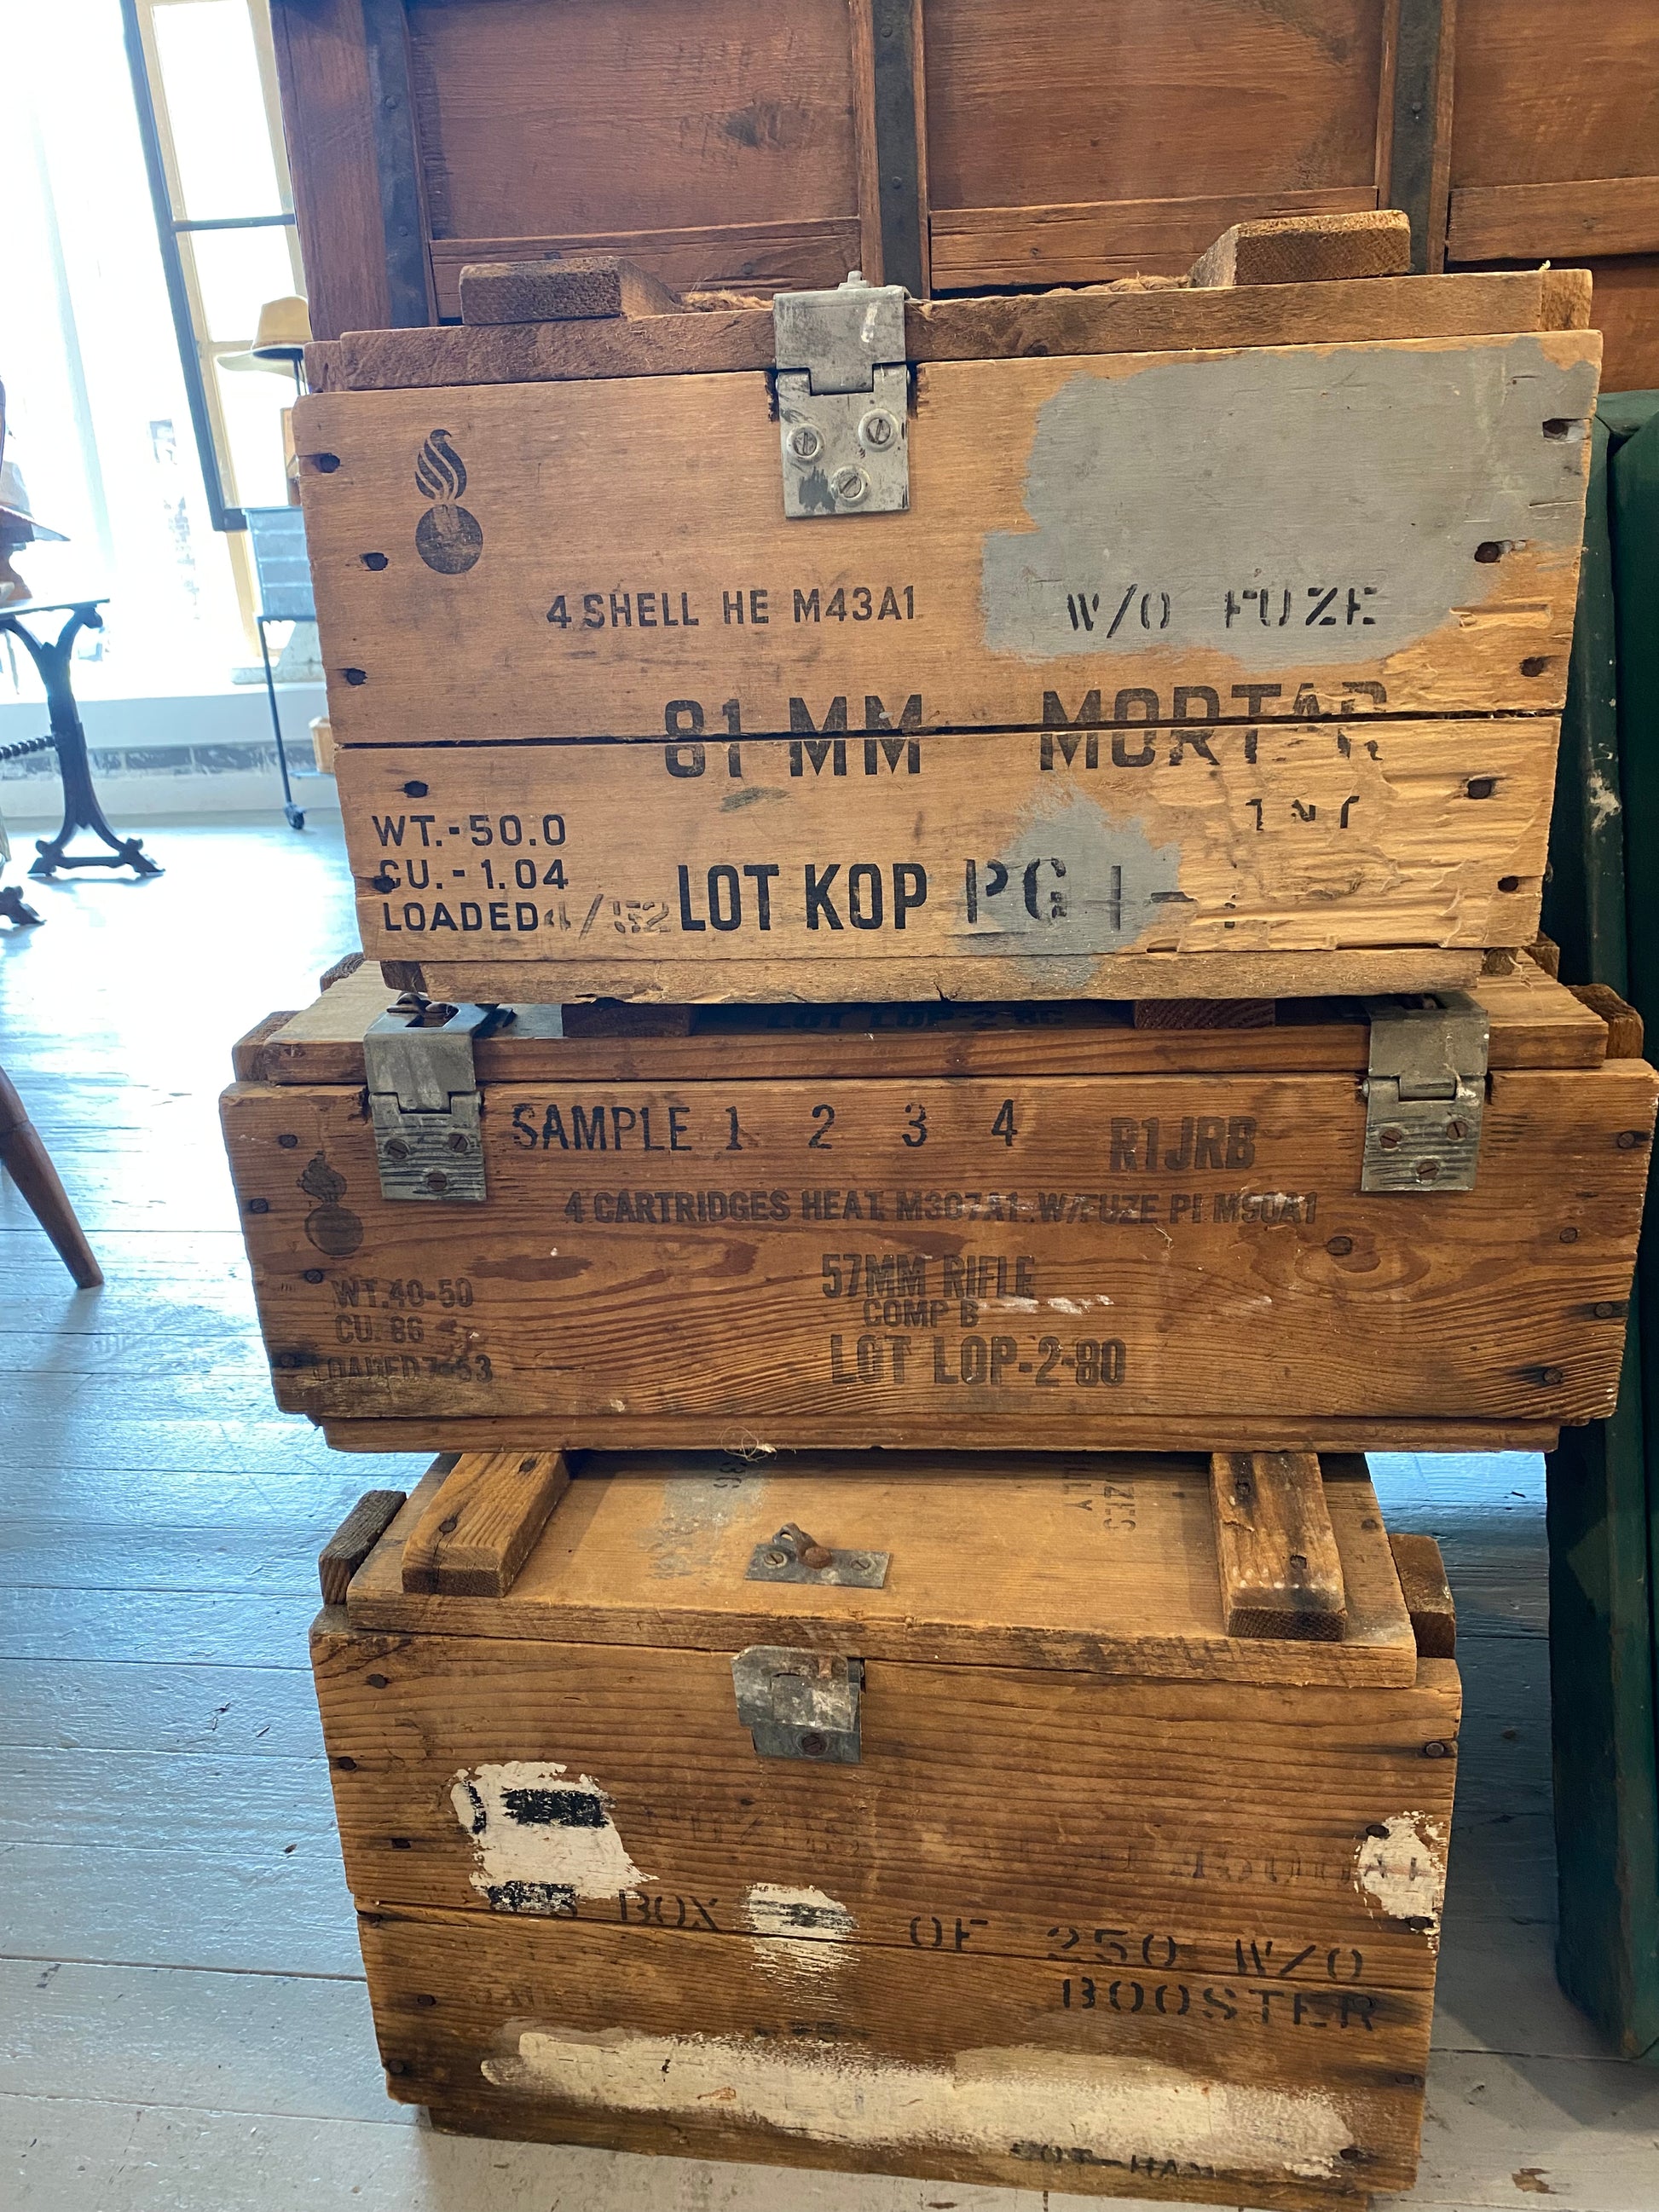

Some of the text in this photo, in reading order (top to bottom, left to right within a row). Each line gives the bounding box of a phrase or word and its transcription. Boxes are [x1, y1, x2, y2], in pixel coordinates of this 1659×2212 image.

[547, 586, 916, 628] 4 SHELL HE M43A1
[1066, 583, 1378, 638] W/O FUZE
[664, 698, 742, 778] 81
[789, 694, 922, 777] MM
[382, 901, 540, 933] LOADED
[678, 863, 779, 932] LOT
[805, 863, 928, 931] KOP
[963, 856, 1066, 925] PG
[512, 1098, 1018, 1152] SAMPLE 1 2 3 4
[564, 1191, 586, 1223] 4
[593, 1188, 791, 1224] CARTRIDGES
[822, 1253, 1036, 1299] 57MM RIFLE
[862, 1297, 980, 1328] COMP B
[830, 1333, 1127, 1387] LOT LOP-2-80
[619, 1888, 720, 1931] BOX
[910, 1915, 989, 1950] OF
[1047, 1926, 1178, 1967] 250
[1235, 1938, 1364, 1980] W/O
[1062, 1977, 1375, 2032] BOOSTER
